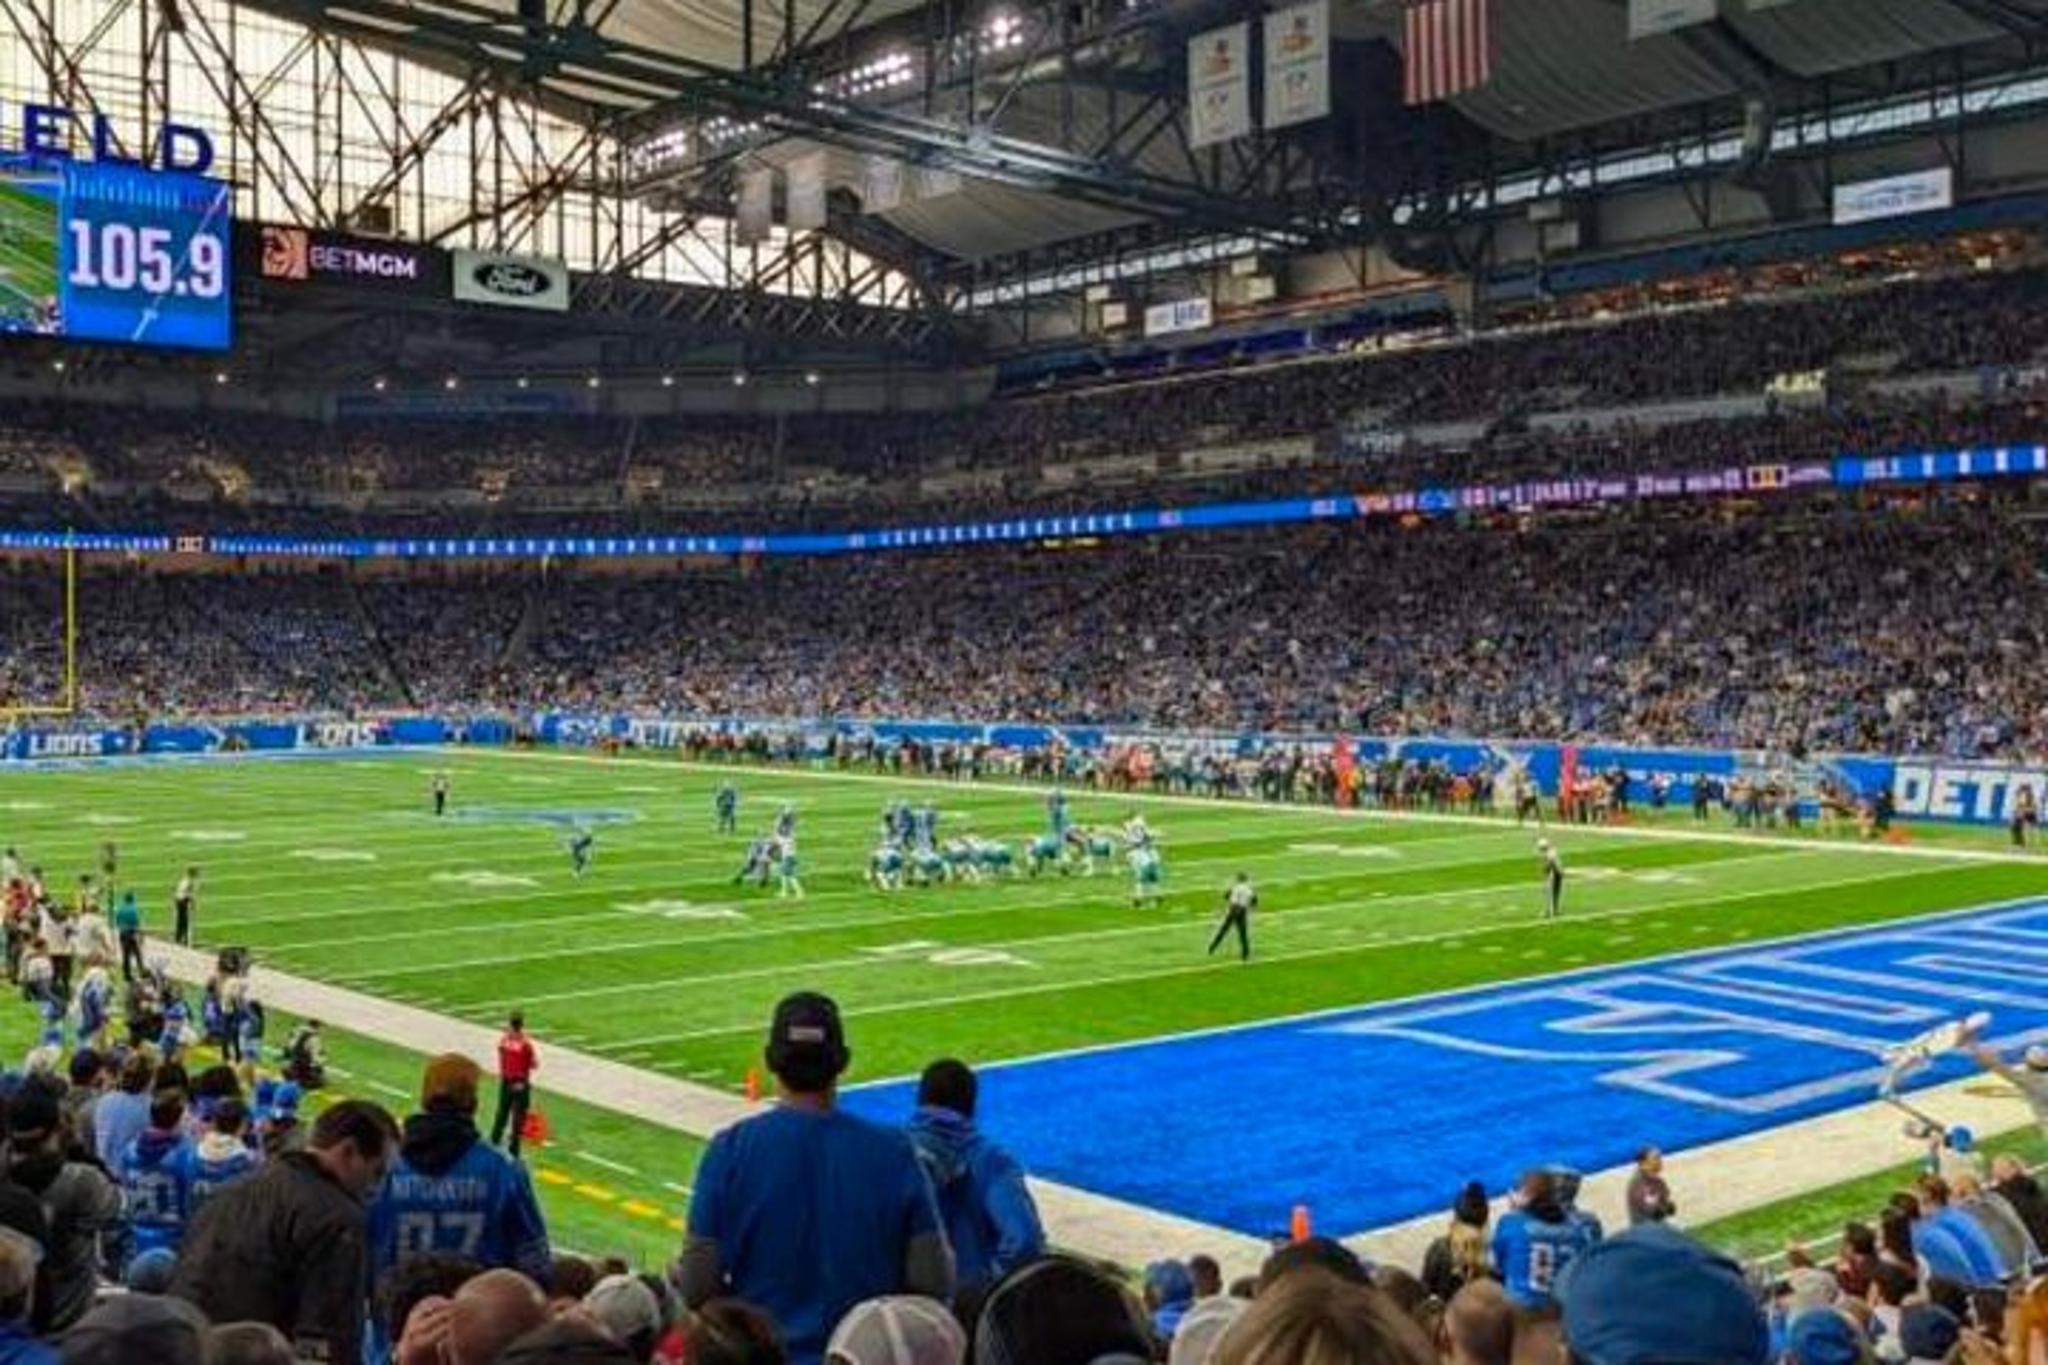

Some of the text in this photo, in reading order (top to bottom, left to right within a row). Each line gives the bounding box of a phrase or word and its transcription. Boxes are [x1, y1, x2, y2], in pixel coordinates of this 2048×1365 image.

[68, 219, 223, 297] 105.9
[310, 246, 417, 279] BETMGM
[486, 264, 540, 293] Ford
